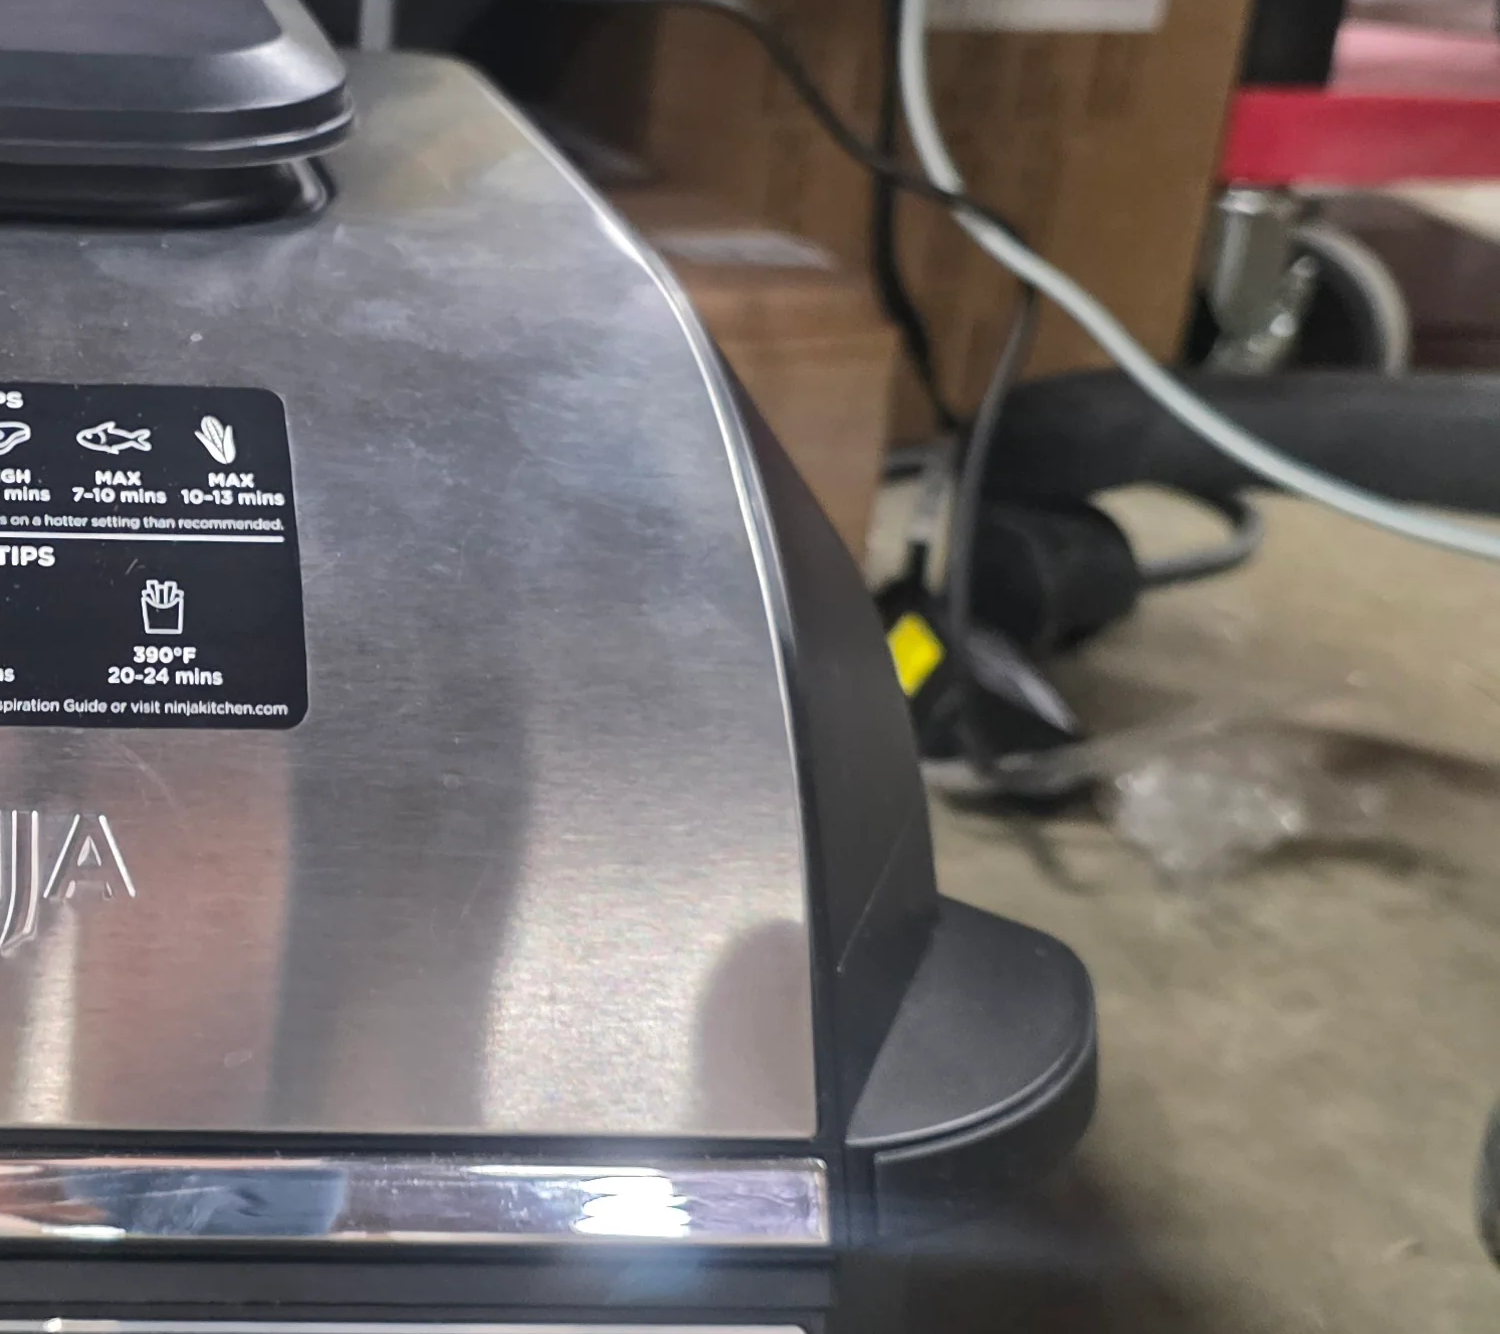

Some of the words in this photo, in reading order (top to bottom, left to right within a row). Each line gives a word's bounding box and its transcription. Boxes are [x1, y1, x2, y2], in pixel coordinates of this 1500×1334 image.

[95, 470, 141, 487] MAX
[208, 472, 255, 489] MAX
[3, 485, 51, 502] mins
[72, 487, 116, 504] 7-10
[120, 487, 167, 505] mins
[180, 489, 233, 506] 10-13
[238, 489, 285, 507] mins
[10, 515, 29, 526] on
[32, 516, 42, 526] a
[44, 514, 88, 527] hotter
[91, 516, 140, 530] setting
[143, 516, 176, 529] than
[178, 518, 285, 531] recommended.
[133, 646, 196, 664] 390°F
[107, 666, 169, 685] 20-24
[175, 666, 223, 686] mins
[63, 698, 107, 713] Guide
[110, 701, 127, 714] or
[130, 700, 160, 714] visit
[164, 700, 289, 716] ninjakitchen.com
